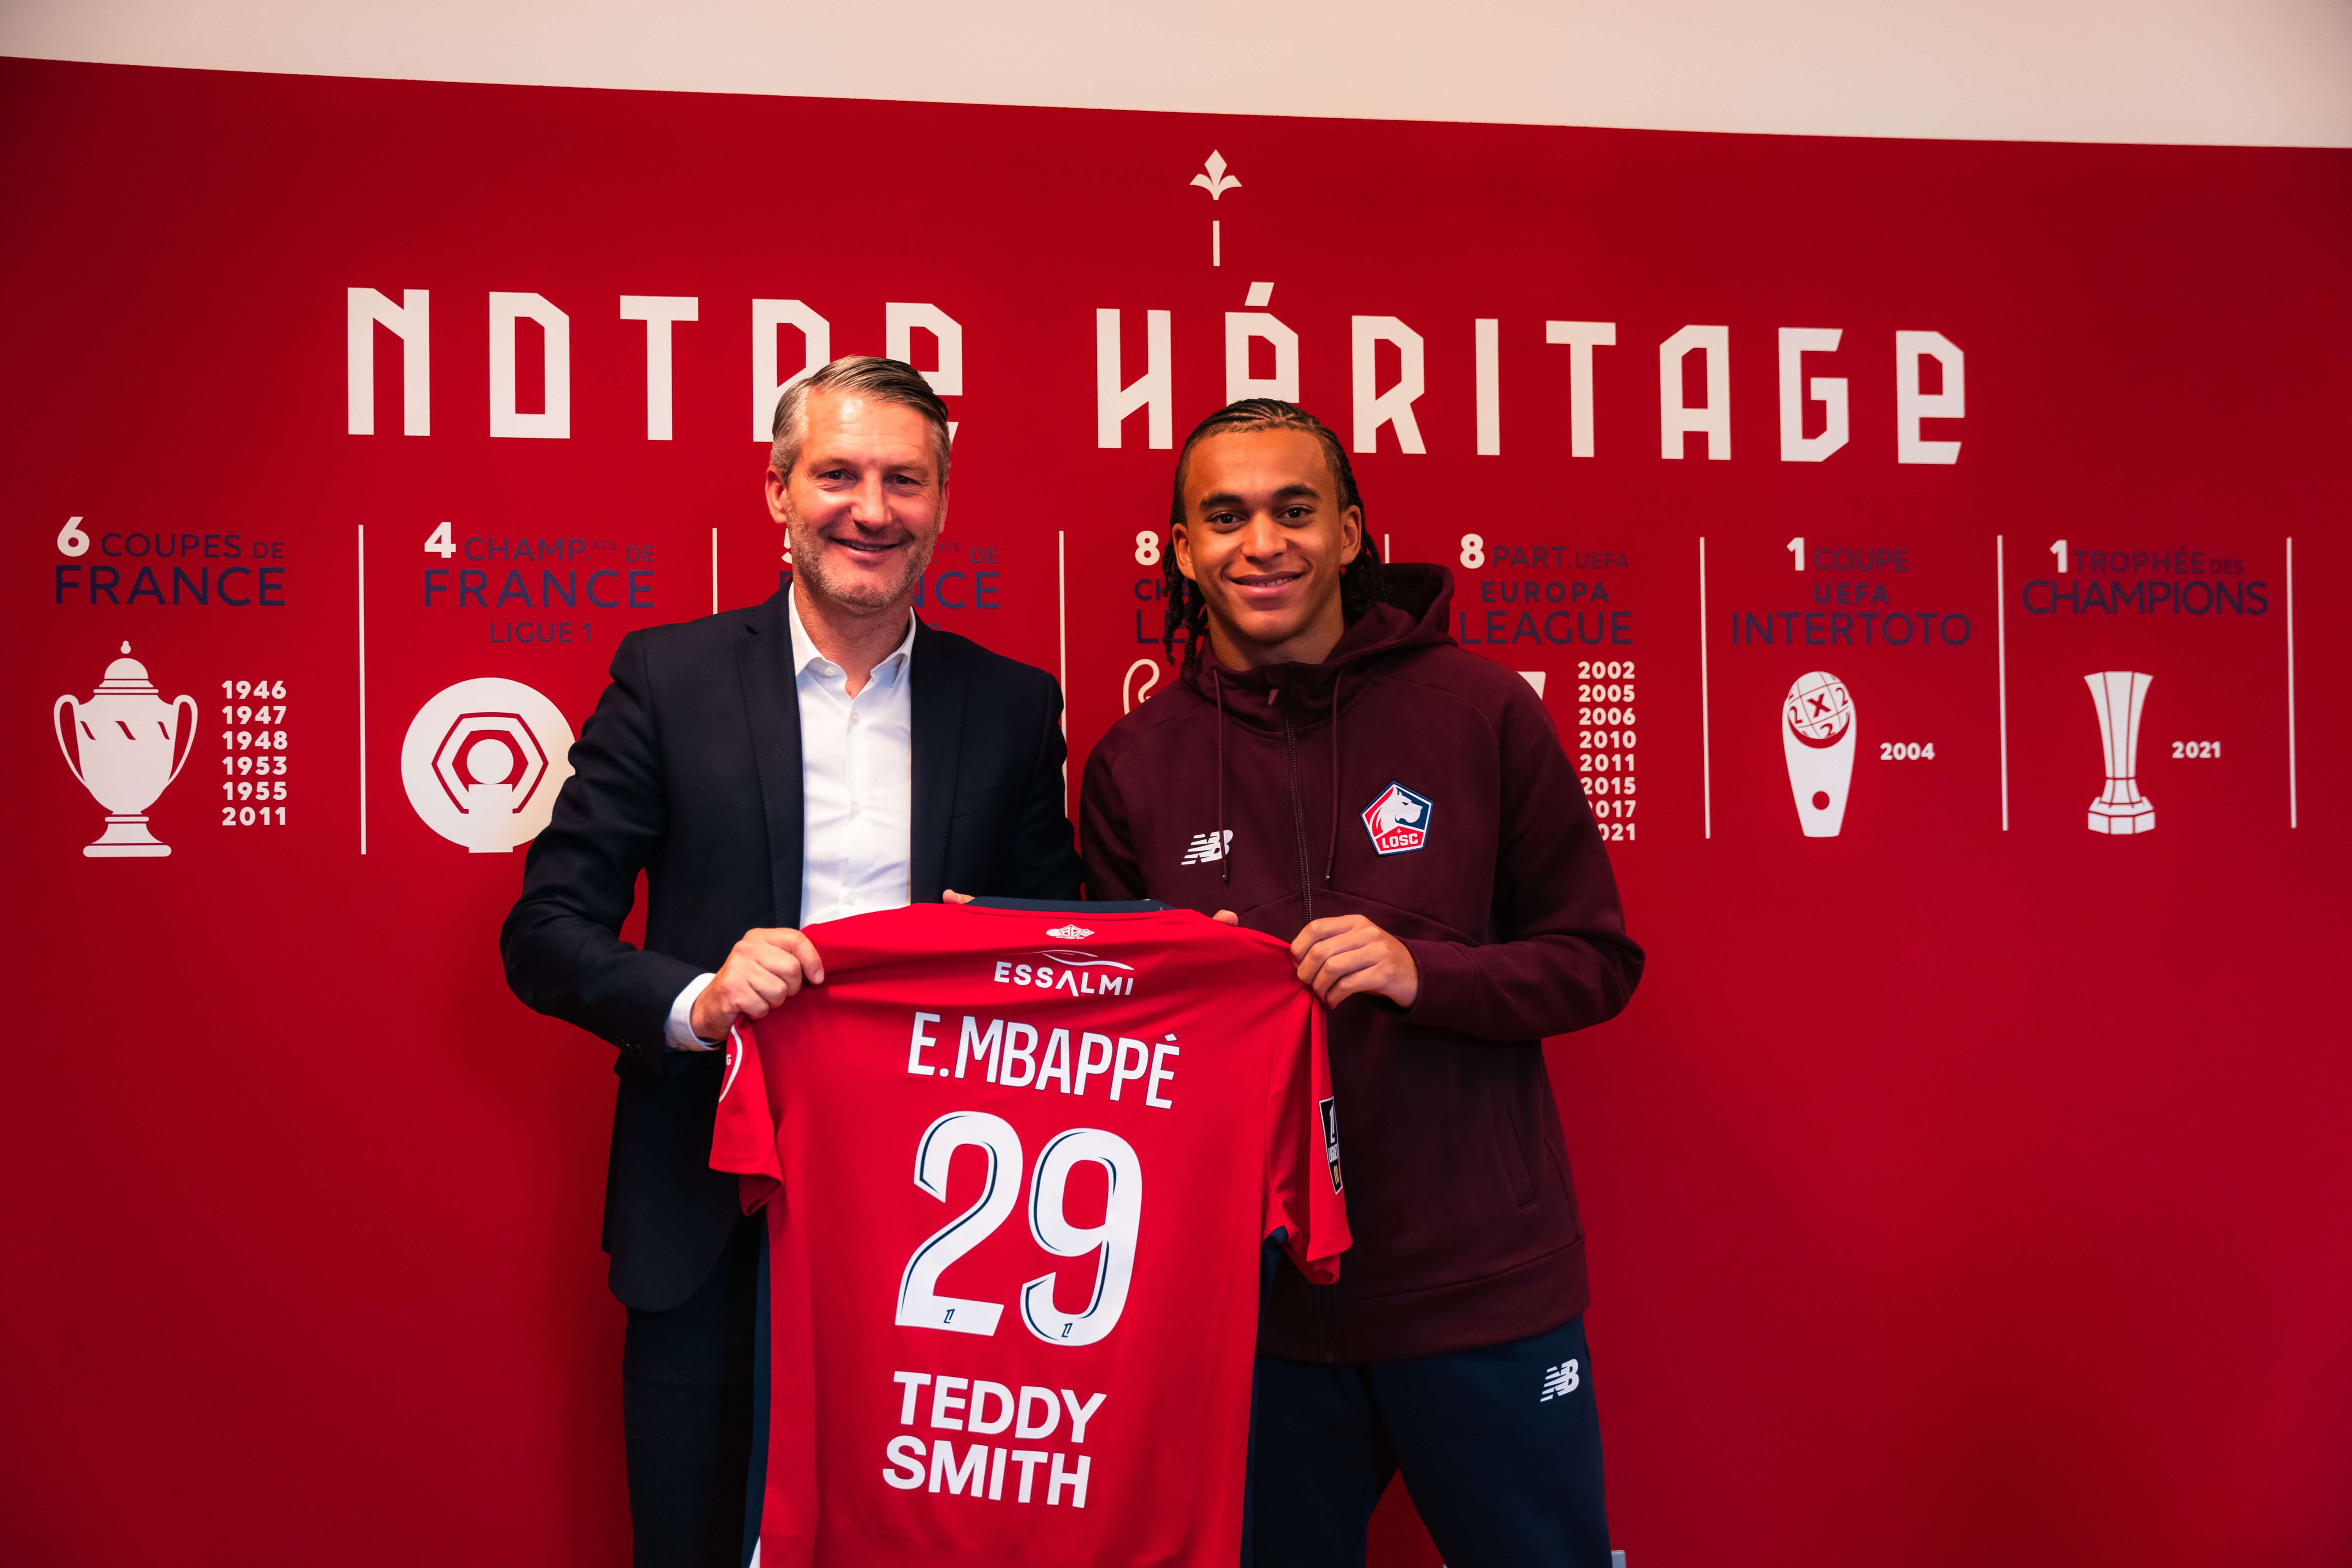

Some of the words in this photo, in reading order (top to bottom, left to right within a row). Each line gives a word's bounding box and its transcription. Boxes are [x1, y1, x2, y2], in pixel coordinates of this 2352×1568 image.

[1096, 282, 1965, 464] HÉRITAGE
[57, 516, 90, 557] 6
[101, 533, 241, 558] COUPES
[253, 542, 283, 559] DE
[424, 522, 456, 558] 4
[626, 545, 654, 562] DE
[970, 547, 997, 564] DE
[1135, 530, 1160, 566] 8
[1460, 534, 1485, 569] 8
[1787, 537, 1805, 571] 1
[1814, 549, 1908, 572] COUPE
[2050, 540, 2068, 573] 1
[2074, 546, 2204, 573] TROPHÉE
[2210, 559, 2243, 575] DES
[56, 565, 285, 606] FRANCE
[425, 569, 653, 608] FRANCE
[1481, 581, 1609, 603] EUROPA
[1814, 584, 1889, 604] UEFA
[2023, 580, 2268, 615] CHAMPIONS
[490, 622, 572, 642] LIGUE
[583, 622, 591, 642] 1
[1460, 610, 1632, 644] LEAGUE
[1733, 612, 1971, 646] INTERTOTO
[1578, 661, 1635, 679] 2002
[221, 680, 287, 699] 1946
[1579, 684, 1635, 702] 2005
[222, 706, 286, 725] 1947
[1579, 707, 1635, 726] 2006
[222, 730, 288, 750] 1948
[1579, 730, 1636, 748] 2010
[1880, 742, 1935, 760] 2004
[2172, 741, 2220, 759] 2021
[222, 756, 287, 775] 1953
[1580, 754, 1634, 772] 2011
[222, 781, 287, 800] 1955
[1580, 777, 1636, 795] 2015
[222, 806, 285, 826] 2011
[1588, 800, 1636, 818] 017
[1382, 833, 1418, 849] LOSC
[1598, 823, 1635, 841] 021
[994, 961, 1134, 997] ESSALMI
[907, 1011, 1180, 1109] E.MBAPPÉ
[895, 1111, 1142, 1347] 29
[893, 1370, 1107, 1443] TEDDY
[882, 1435, 1091, 1508] SMITH
